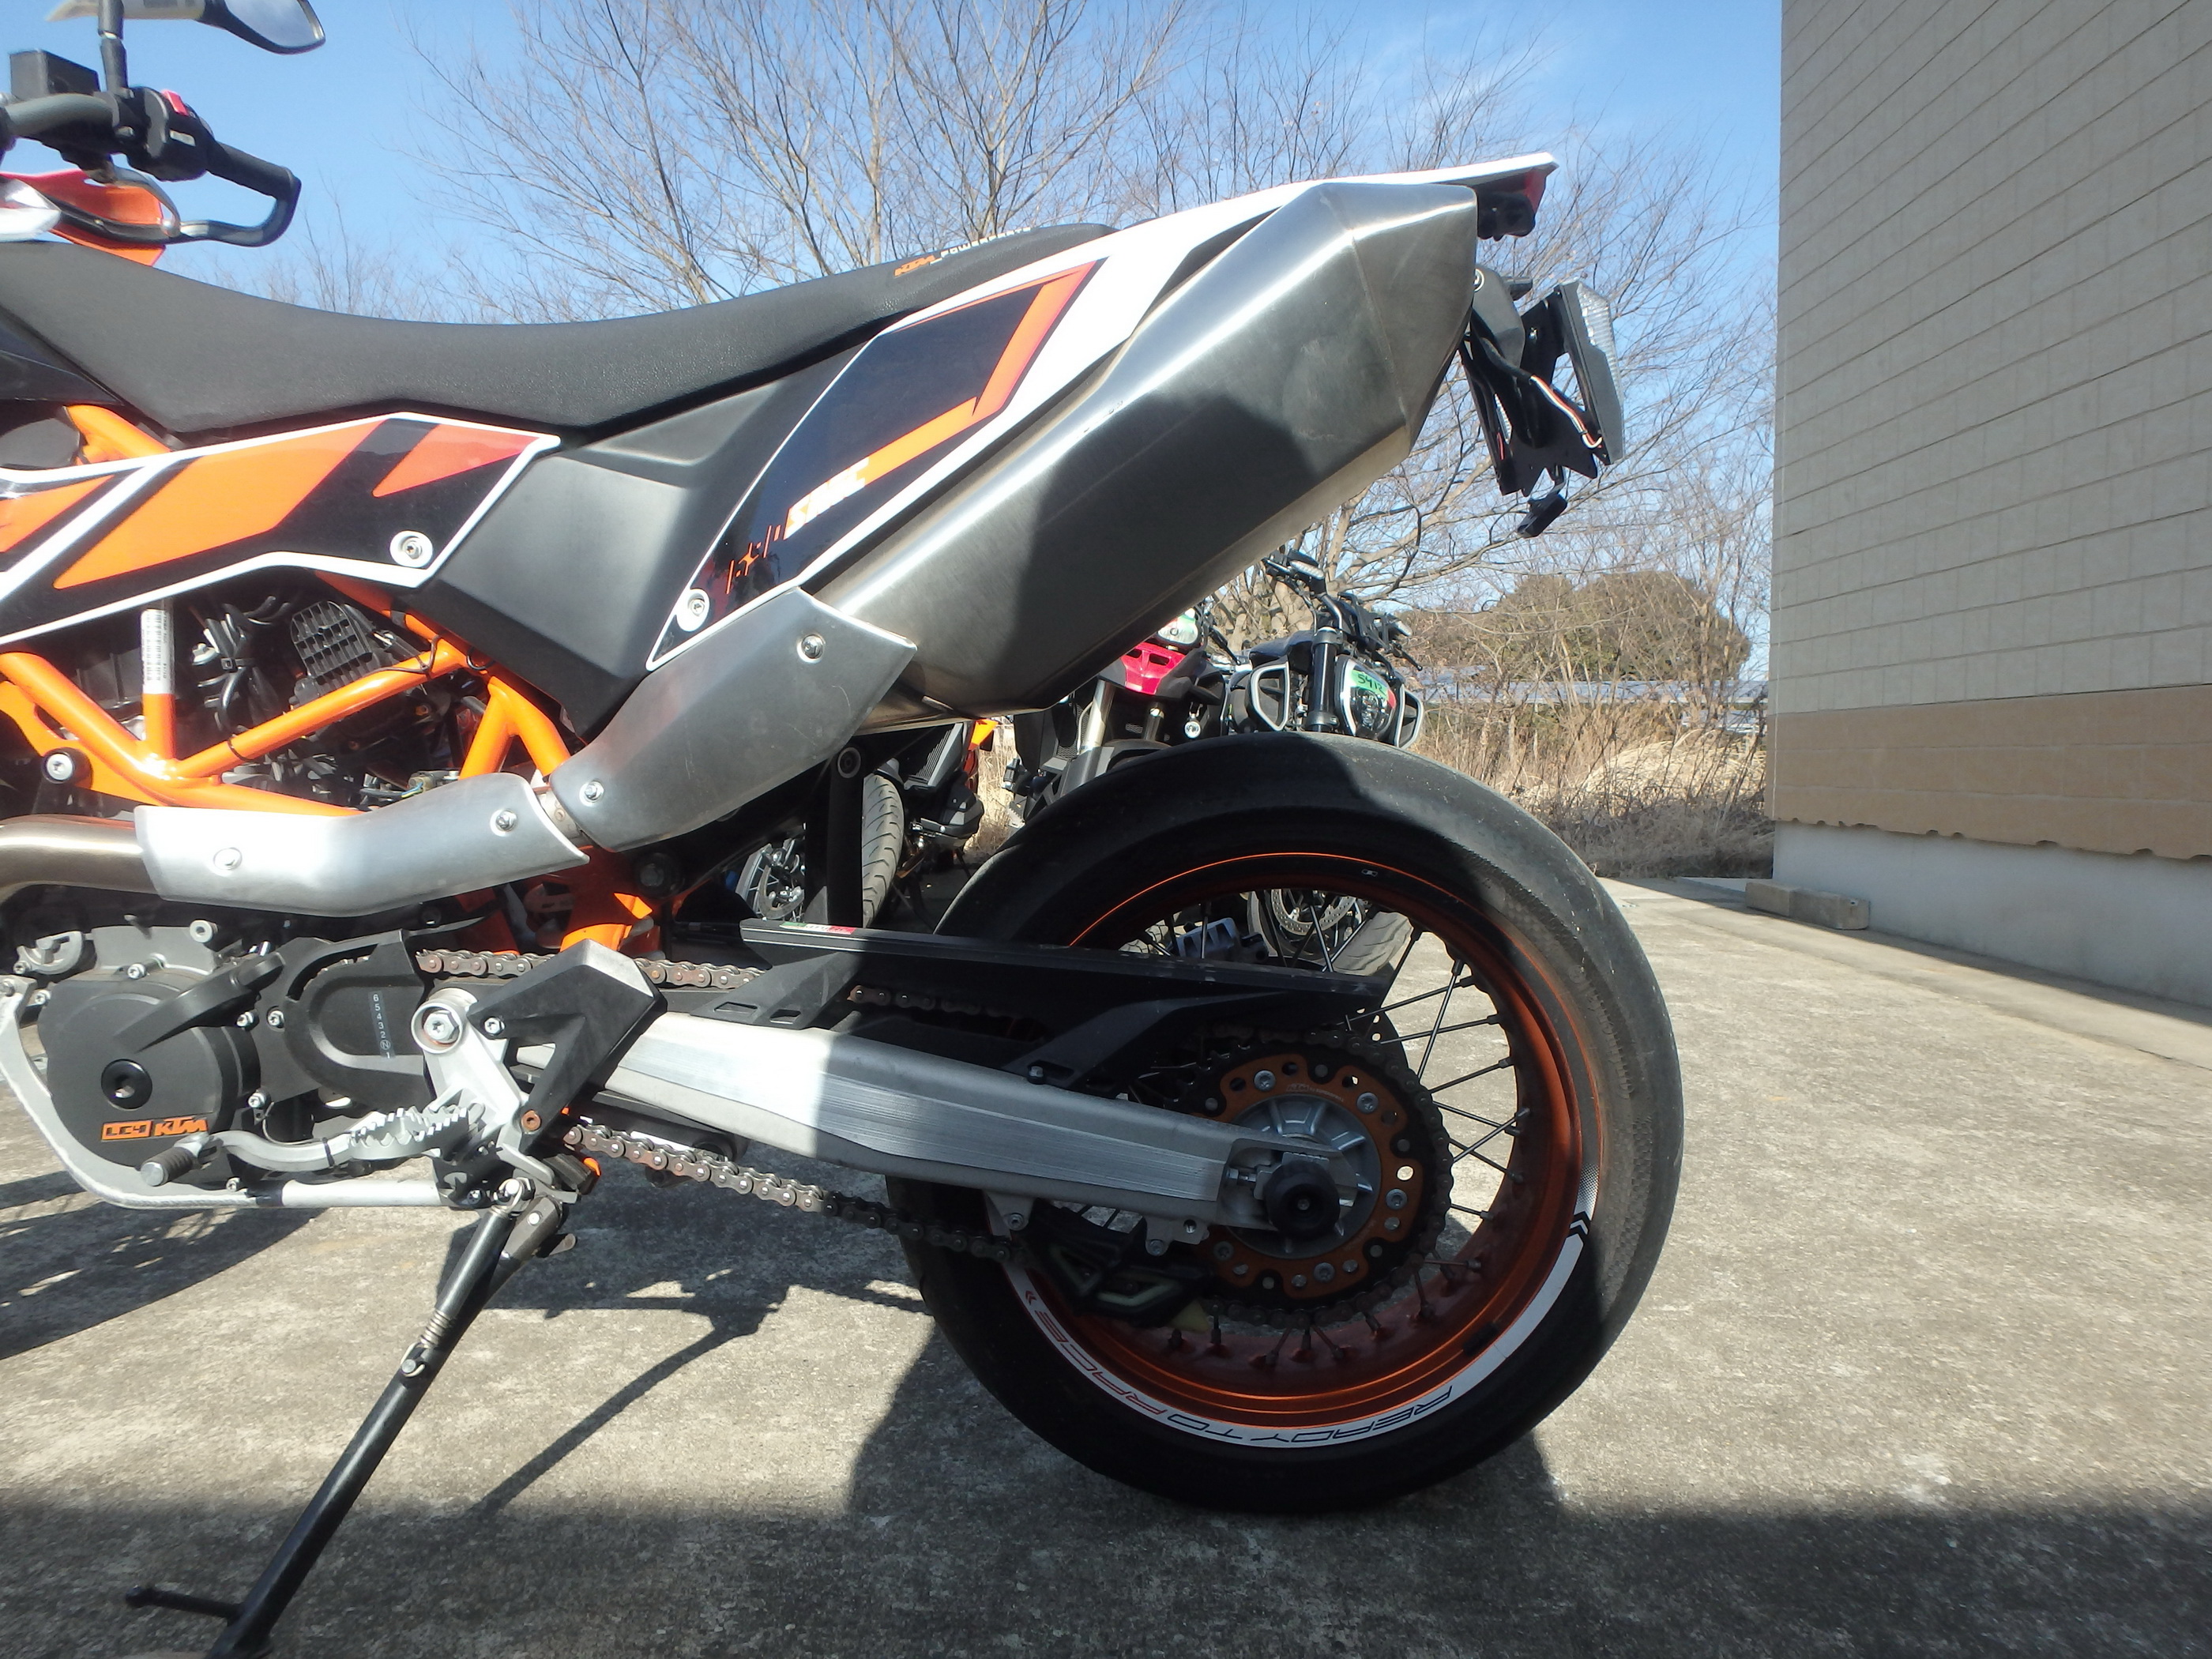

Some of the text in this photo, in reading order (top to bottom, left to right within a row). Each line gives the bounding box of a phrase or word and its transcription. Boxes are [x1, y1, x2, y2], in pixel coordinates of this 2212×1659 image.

[893, 254, 936, 277] KTM
[104, 1116, 208, 1138] LC4 KTM
[1034, 1310, 1453, 1443] READY TO RACE
